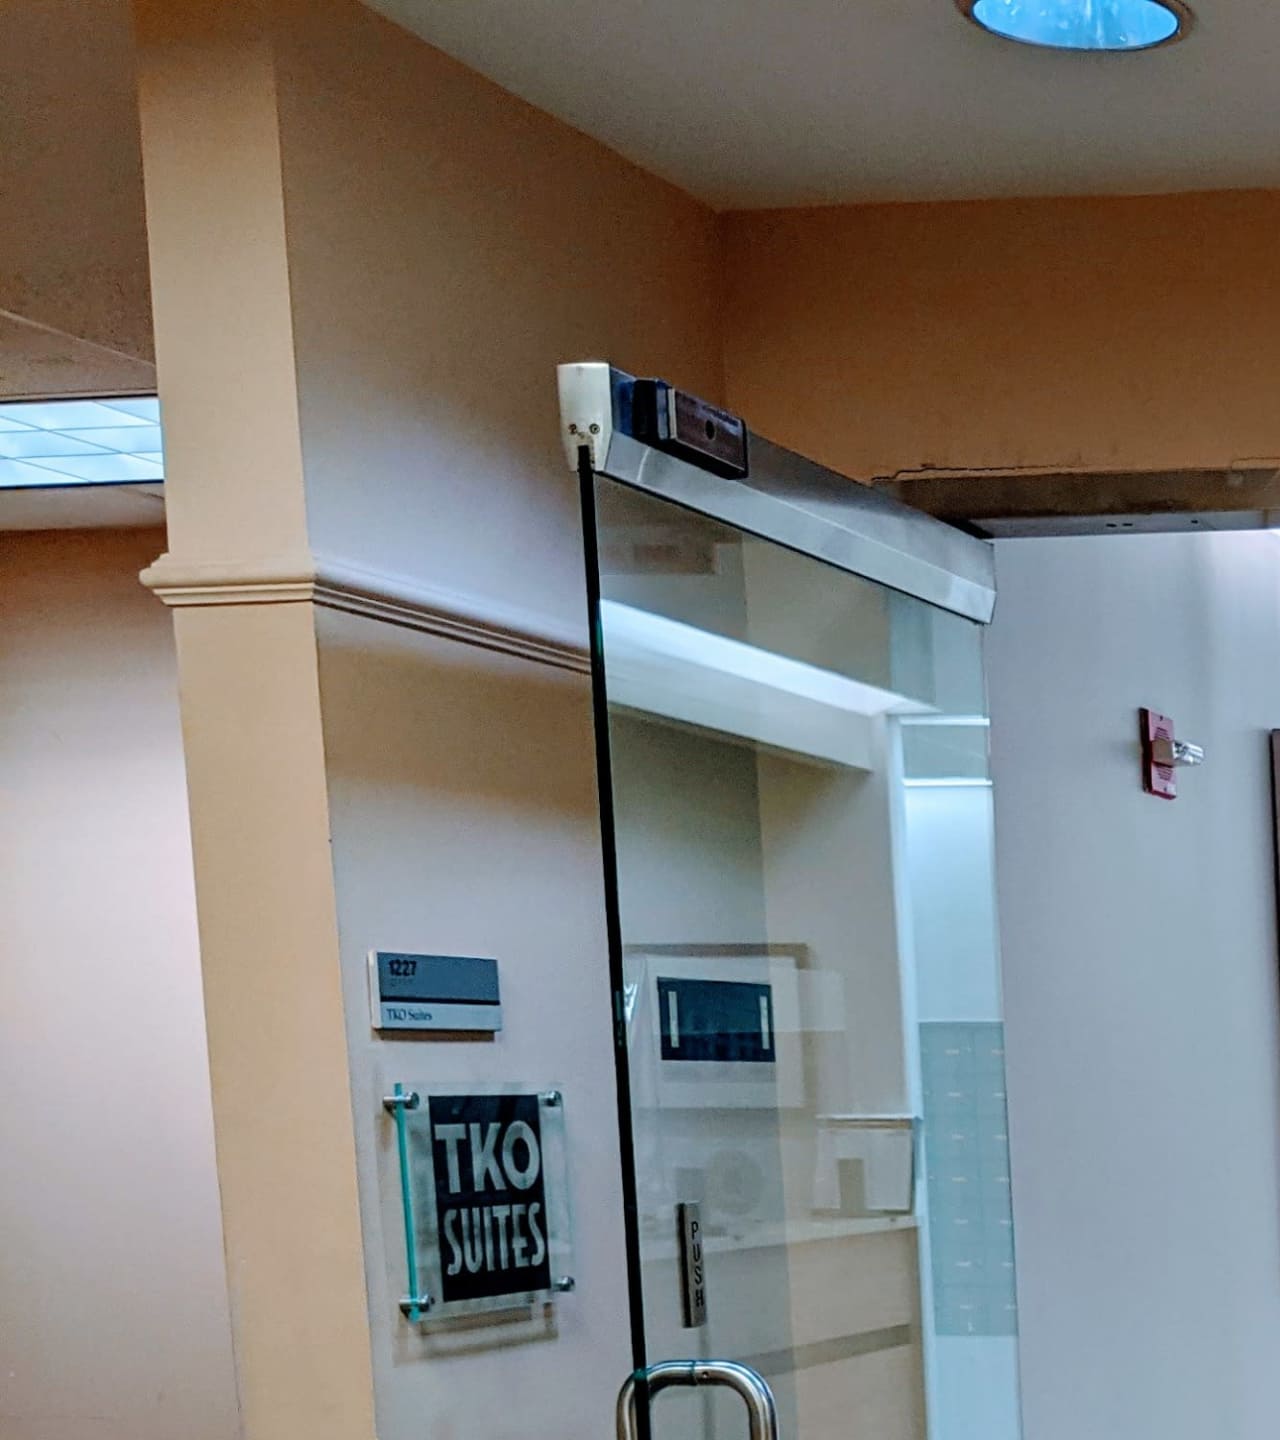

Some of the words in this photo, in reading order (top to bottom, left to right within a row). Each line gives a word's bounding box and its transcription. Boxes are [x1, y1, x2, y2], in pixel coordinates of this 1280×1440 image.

[388, 958, 417, 977] 1227
[386, 1007, 407, 1021] TKO
[434, 1120, 541, 1194] TKO
[443, 1201, 547, 1276] SUITES
[691, 1221, 704, 1307] PUSH
